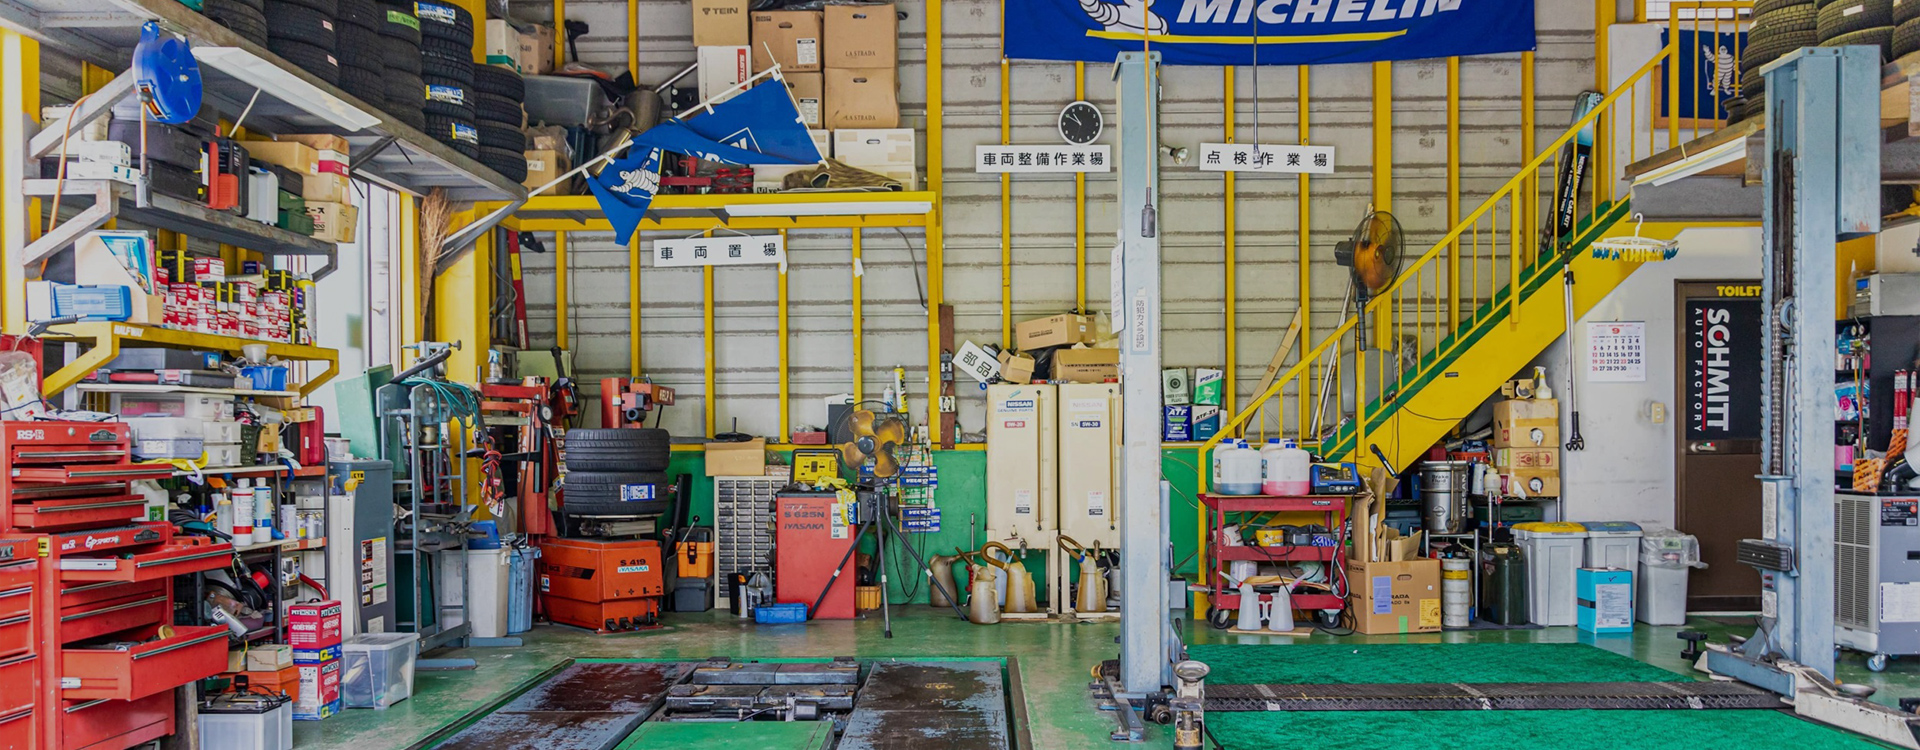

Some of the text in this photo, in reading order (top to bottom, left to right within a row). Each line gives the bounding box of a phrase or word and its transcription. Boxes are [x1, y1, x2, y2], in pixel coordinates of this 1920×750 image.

[712, 7, 739, 15] TEIN
[1176, 0, 1461, 23] MICHELIN
[983, 152, 1104, 166] 車両整備作業場
[1206, 150, 1327, 167] 点検作業場
[661, 243, 776, 260] 車両置場
[1716, 286, 1762, 297] TOILET
[962, 350, 992, 378] 部品
[1694, 307, 1703, 432] AUTO FACTORY
[1707, 308, 1731, 431] SCHMITT
